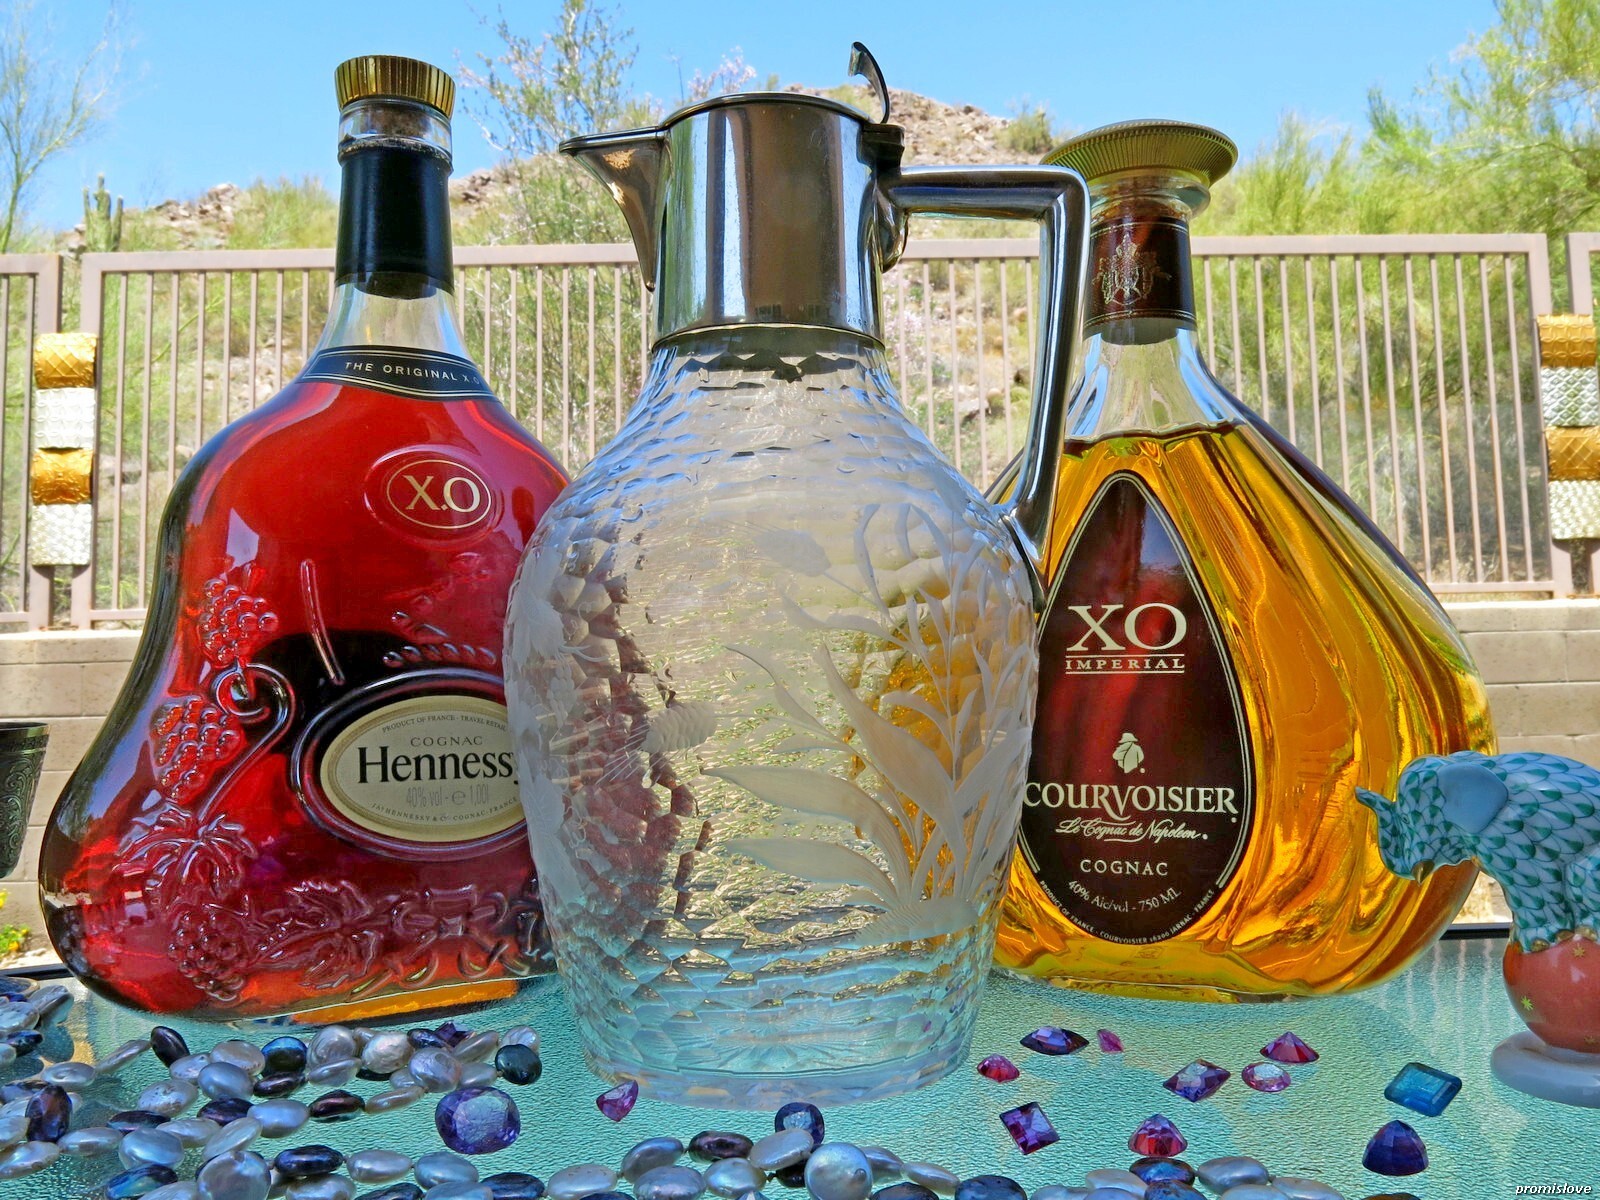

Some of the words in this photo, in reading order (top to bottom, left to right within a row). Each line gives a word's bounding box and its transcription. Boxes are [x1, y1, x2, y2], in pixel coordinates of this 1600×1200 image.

[345, 361, 374, 372] THE
[382, 364, 458, 381] ORIGINAL
[1066, 602, 1187, 651] XO
[1065, 658, 1185, 670] IMPERIAL
[382, 718, 415, 733] PRODUCT
[416, 715, 425, 723] OF
[461, 715, 485, 725] TRAVEL
[486, 720, 507, 732] RETAIL
[410, 735, 483, 747] COGNAC
[357, 746, 519, 785] Henness
[406, 787, 427, 808] 40%
[428, 787, 443, 807] vol
[385, 808, 430, 821] HENNESSY
[1056, 816, 1081, 834] Le
[1080, 818, 1130, 840] Cognac
[1080, 859, 1168, 876] COGNAC
[1068, 880, 1090, 901] 40%
[1138, 896, 1160, 912] 750
[1160, 887, 1182, 904] ML
[1040, 880, 1063, 909] PRODUCT
[1061, 907, 1071, 916] OF
[1069, 914, 1095, 933] FRANCE
[1099, 930, 1148, 944] COURVOISIER
[1169, 913, 1193, 934] JARNAC
[1193, 889, 1215, 913] FRANCE
